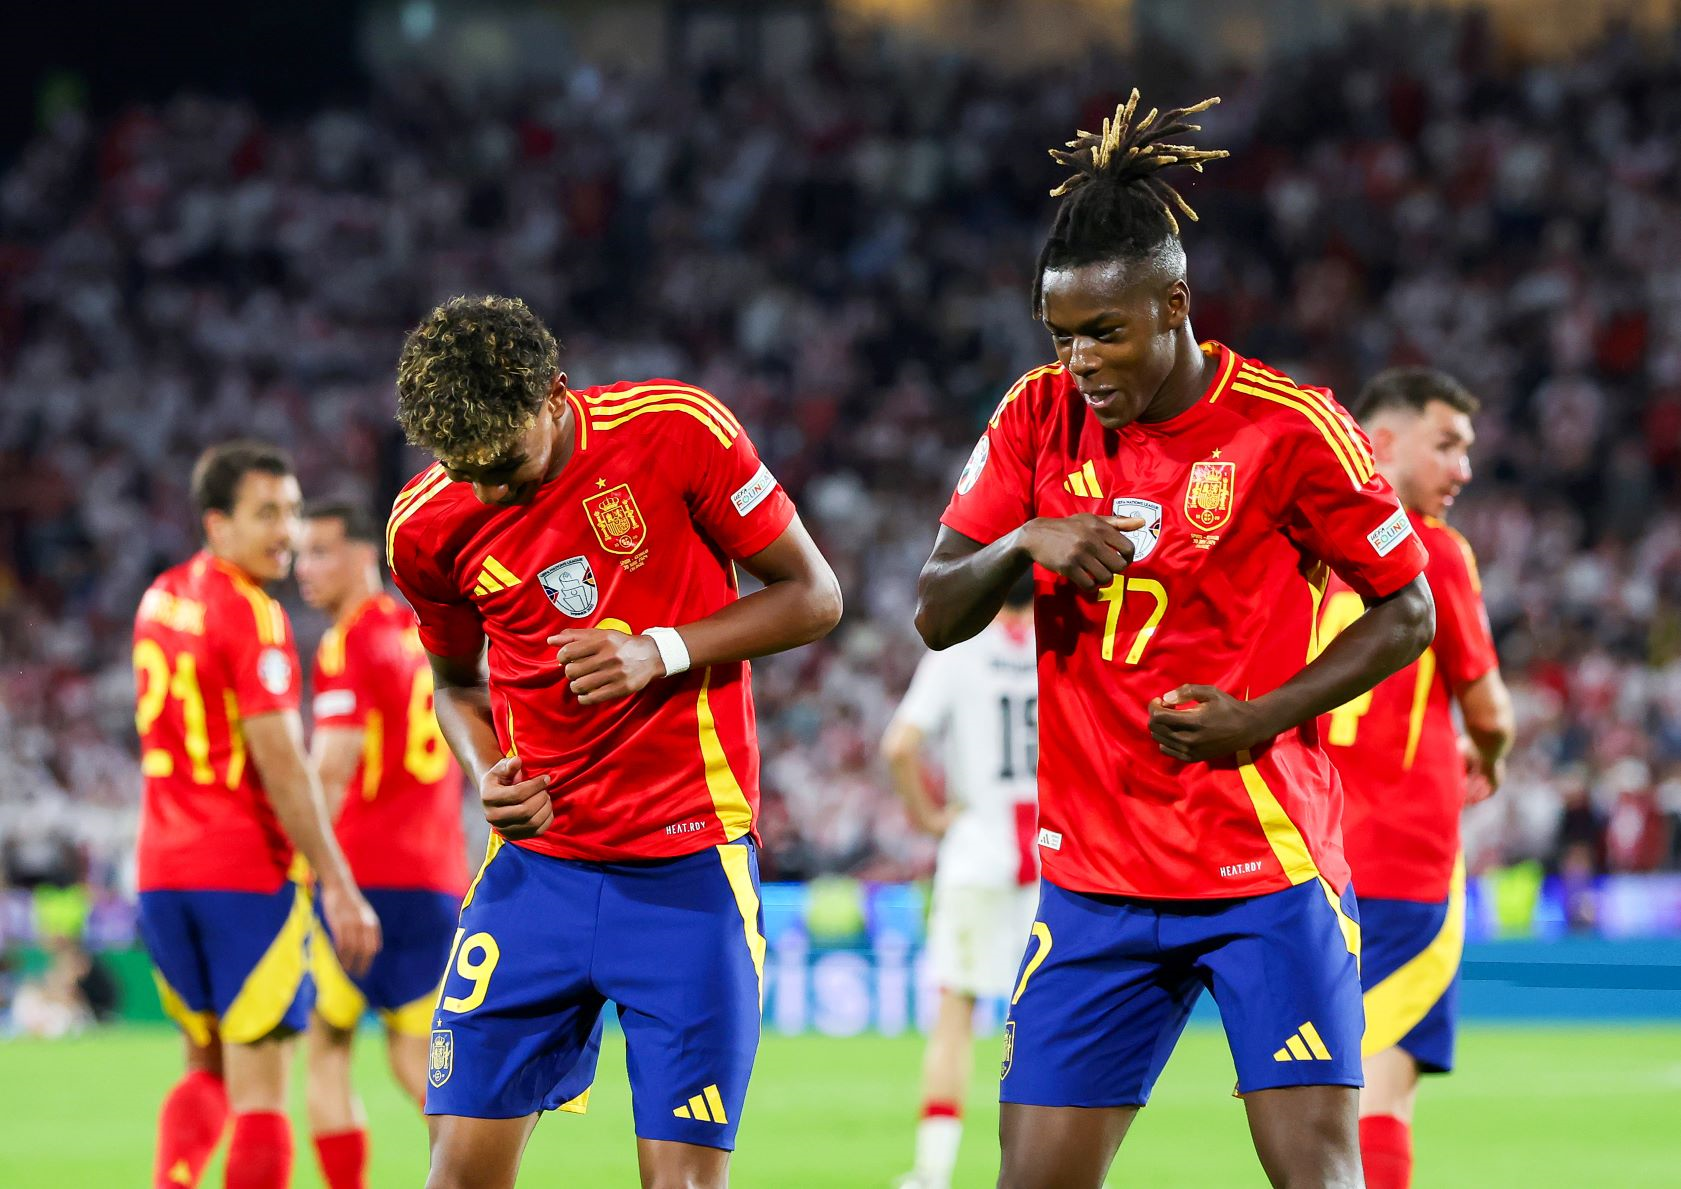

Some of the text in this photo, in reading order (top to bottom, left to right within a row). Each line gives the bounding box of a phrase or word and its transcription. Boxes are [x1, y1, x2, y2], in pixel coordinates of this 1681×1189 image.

[1098, 573, 1168, 664] 17
[133, 638, 216, 785] 21
[665, 820, 706, 835] HEAT.RDY
[1219, 860, 1262, 877] HEAT.RDY
[435, 927, 500, 1014] 19
